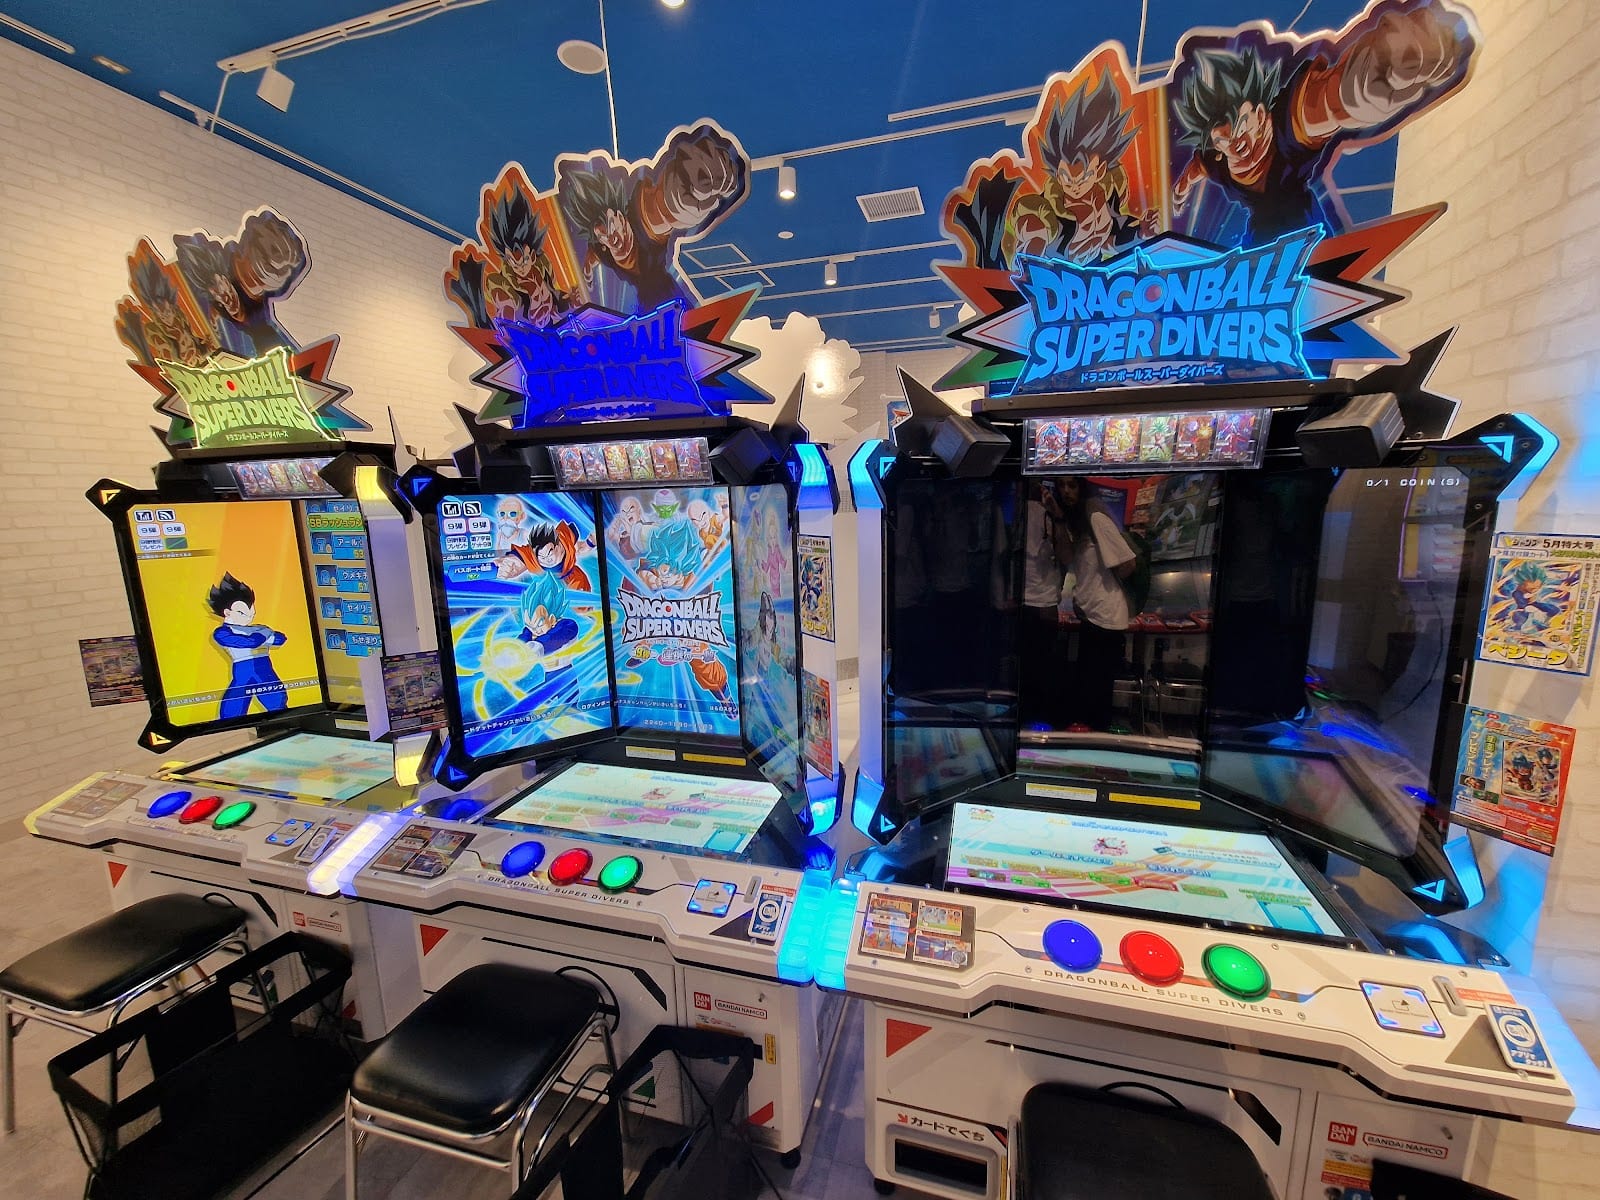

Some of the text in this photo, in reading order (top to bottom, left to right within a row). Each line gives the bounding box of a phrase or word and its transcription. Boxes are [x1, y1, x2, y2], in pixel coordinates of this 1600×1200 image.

[1026, 238, 1308, 322] DRAGONBALL
[505, 310, 682, 372] DRAGONBALL
[1024, 309, 1298, 384] SUPER DIVERS
[167, 355, 295, 402] DRAGONBALL
[1080, 364, 1225, 382] ドラゴンボールスーパーダイバーズ
[527, 361, 702, 417] SUPER DIVERS
[192, 396, 318, 439] SUPER DIVERS
[1366, 478, 1389, 487] 0/1
[1543, 539, 1594, 549] 5月特大号
[619, 590, 721, 619] DRAGONBALL
[623, 618, 728, 646] SUPER DIVERS
[1489, 644, 1569, 666] ベジータ
[554, 887, 588, 898] SUPER
[591, 893, 630, 905] DIVERS
[1044, 969, 1284, 1017] DRAGONBALL SUPER DIVERS
[911, 1116, 985, 1142] カードでくち
[1330, 1132, 1350, 1143] DAI
[1331, 1123, 1355, 1136] BAN
[1405, 1144, 1443, 1156] NAMCO
